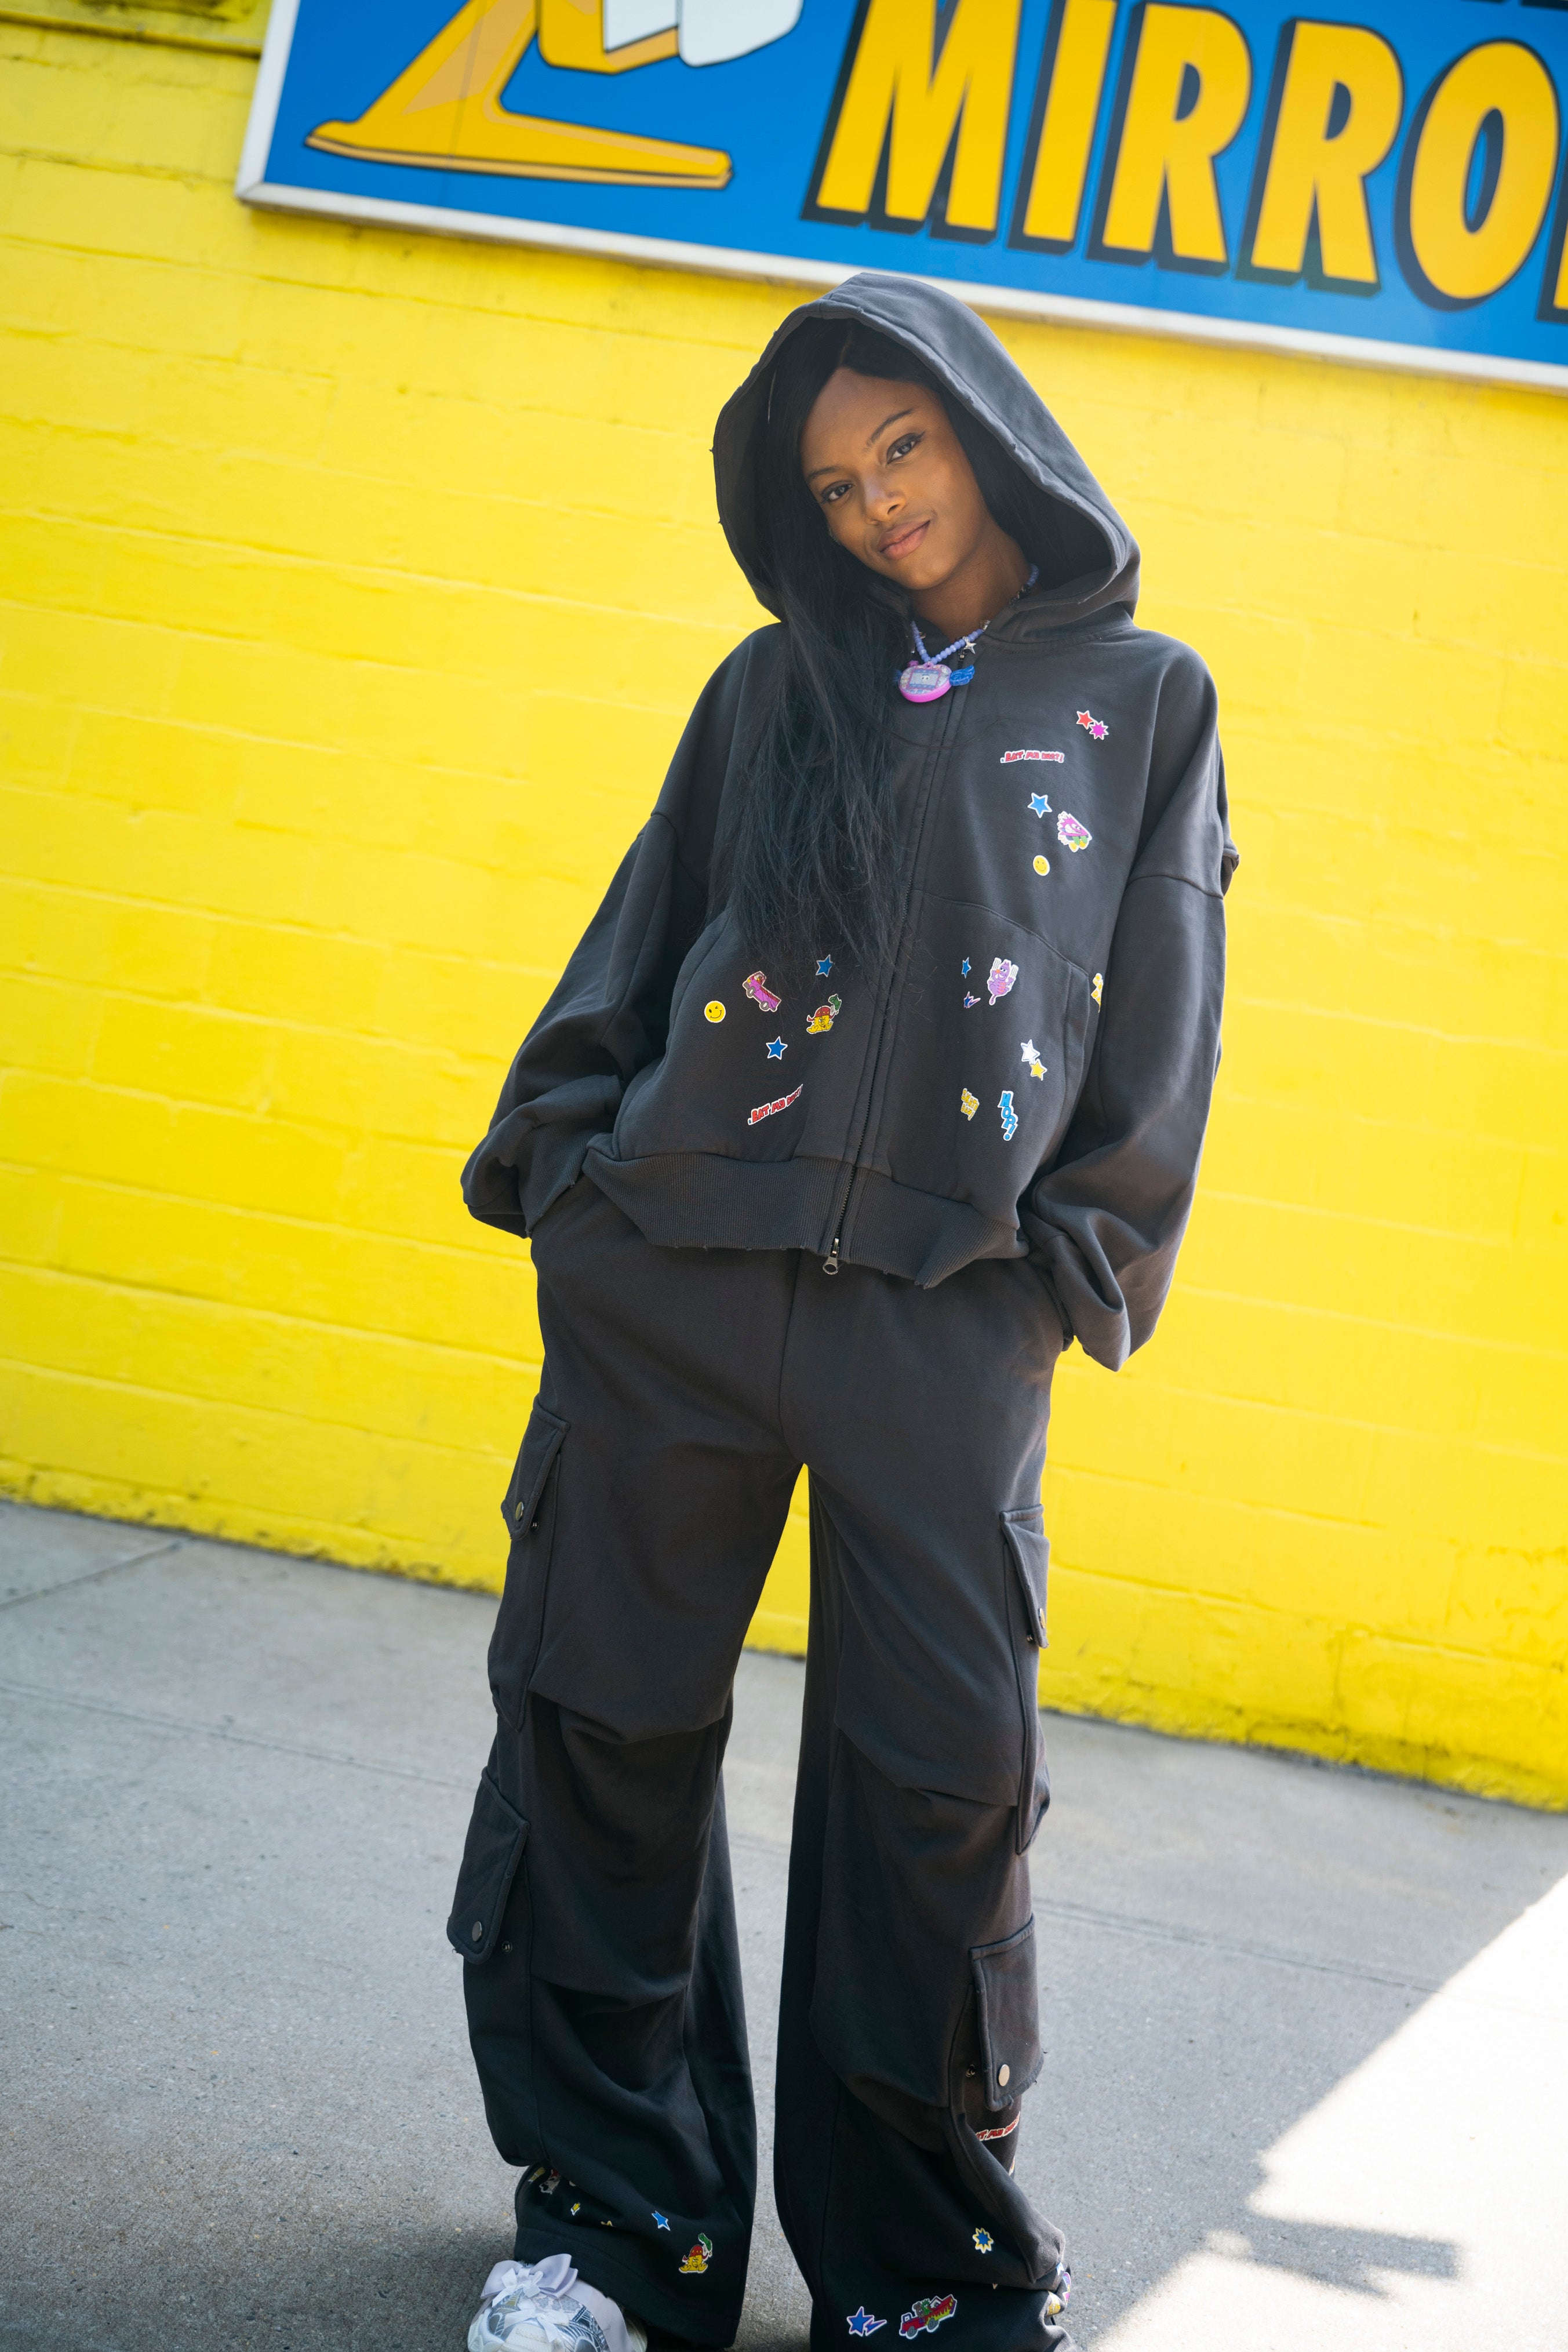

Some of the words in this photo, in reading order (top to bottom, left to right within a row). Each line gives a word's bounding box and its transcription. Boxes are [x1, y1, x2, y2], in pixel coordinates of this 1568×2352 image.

[803, 0, 1568, 321] MIRRO
[1005, 751, 1024, 762] EAT
[752, 1105, 770, 1123] EAT
[771, 1099, 785, 1113] MY
